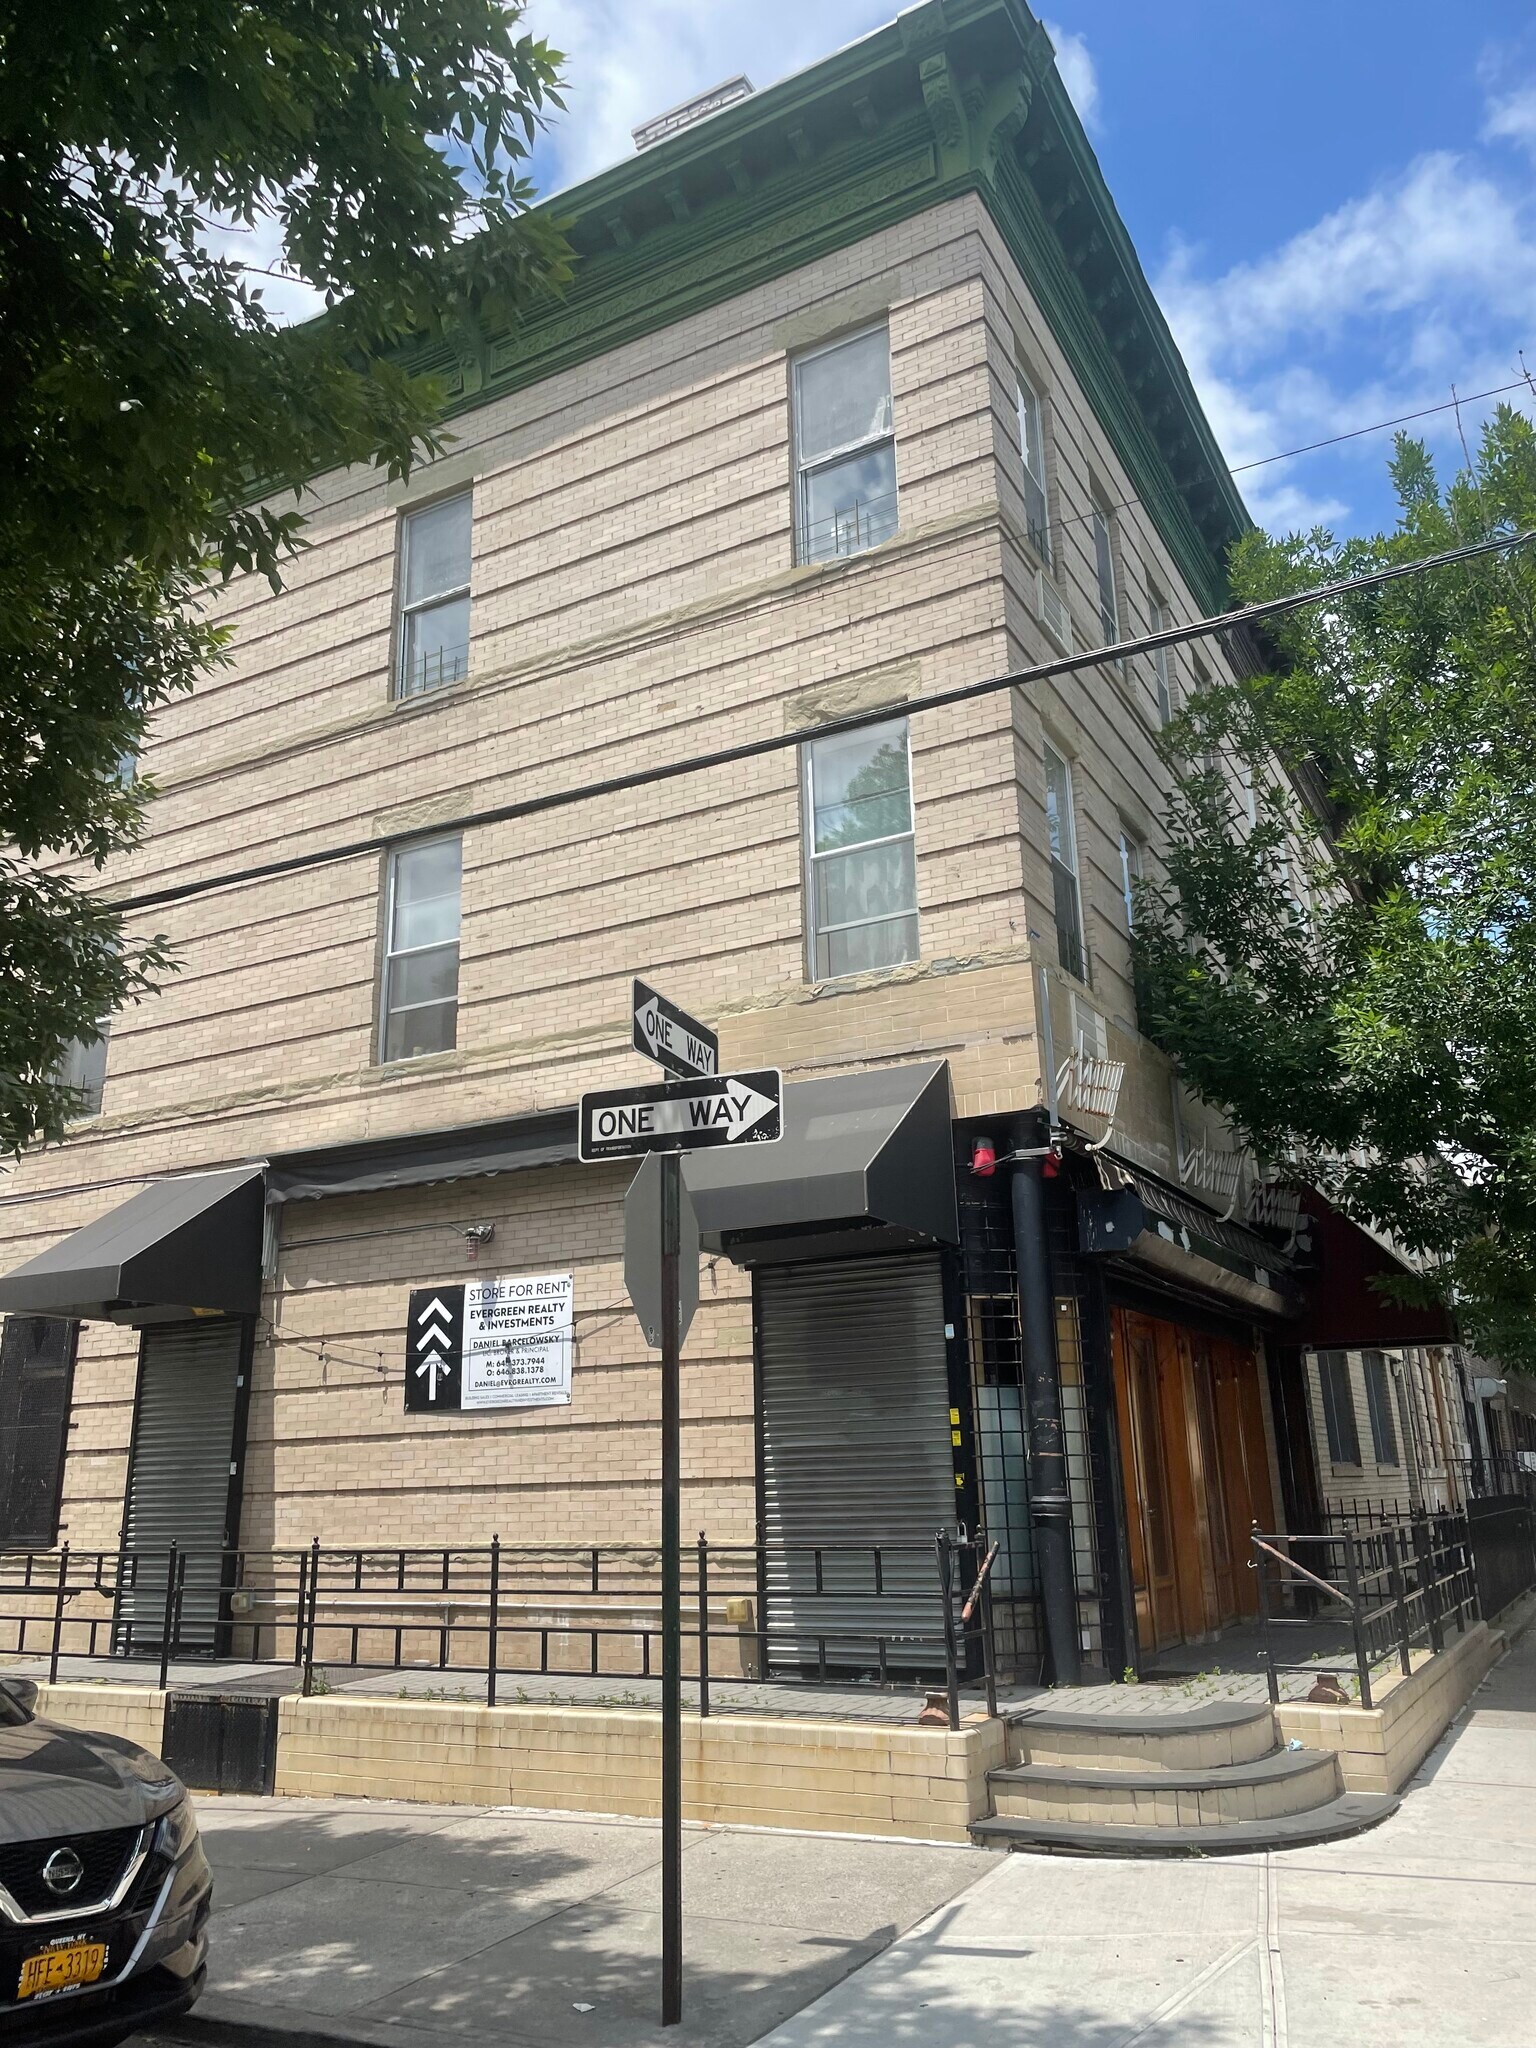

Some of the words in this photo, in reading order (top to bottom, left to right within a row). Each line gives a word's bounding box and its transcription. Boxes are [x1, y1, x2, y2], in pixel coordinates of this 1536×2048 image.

[646, 1009, 673, 1049] ONE
[687, 1035, 711, 1073] WAY
[598, 1107, 654, 1137] ONE
[689, 1094, 752, 1127] WAY
[469, 1286, 506, 1301] STORE
[509, 1284, 533, 1298] FOR
[536, 1281, 568, 1295] RENT
[470, 1305, 526, 1319] EVERGREEN
[528, 1302, 565, 1315] REALTY
[479, 1321, 486, 1331] &
[488, 1316, 555, 1331] INVESTMENTS
[473, 1339, 500, 1349] DANIEL
[521, 1346, 549, 1354] PRINCIPAL
[486, 1360, 495, 1368] M:
[496, 1357, 545, 1368] 64.373.7944
[486, 1369, 495, 1377] O:
[496, 1366, 544, 1376] 646.838.1378
